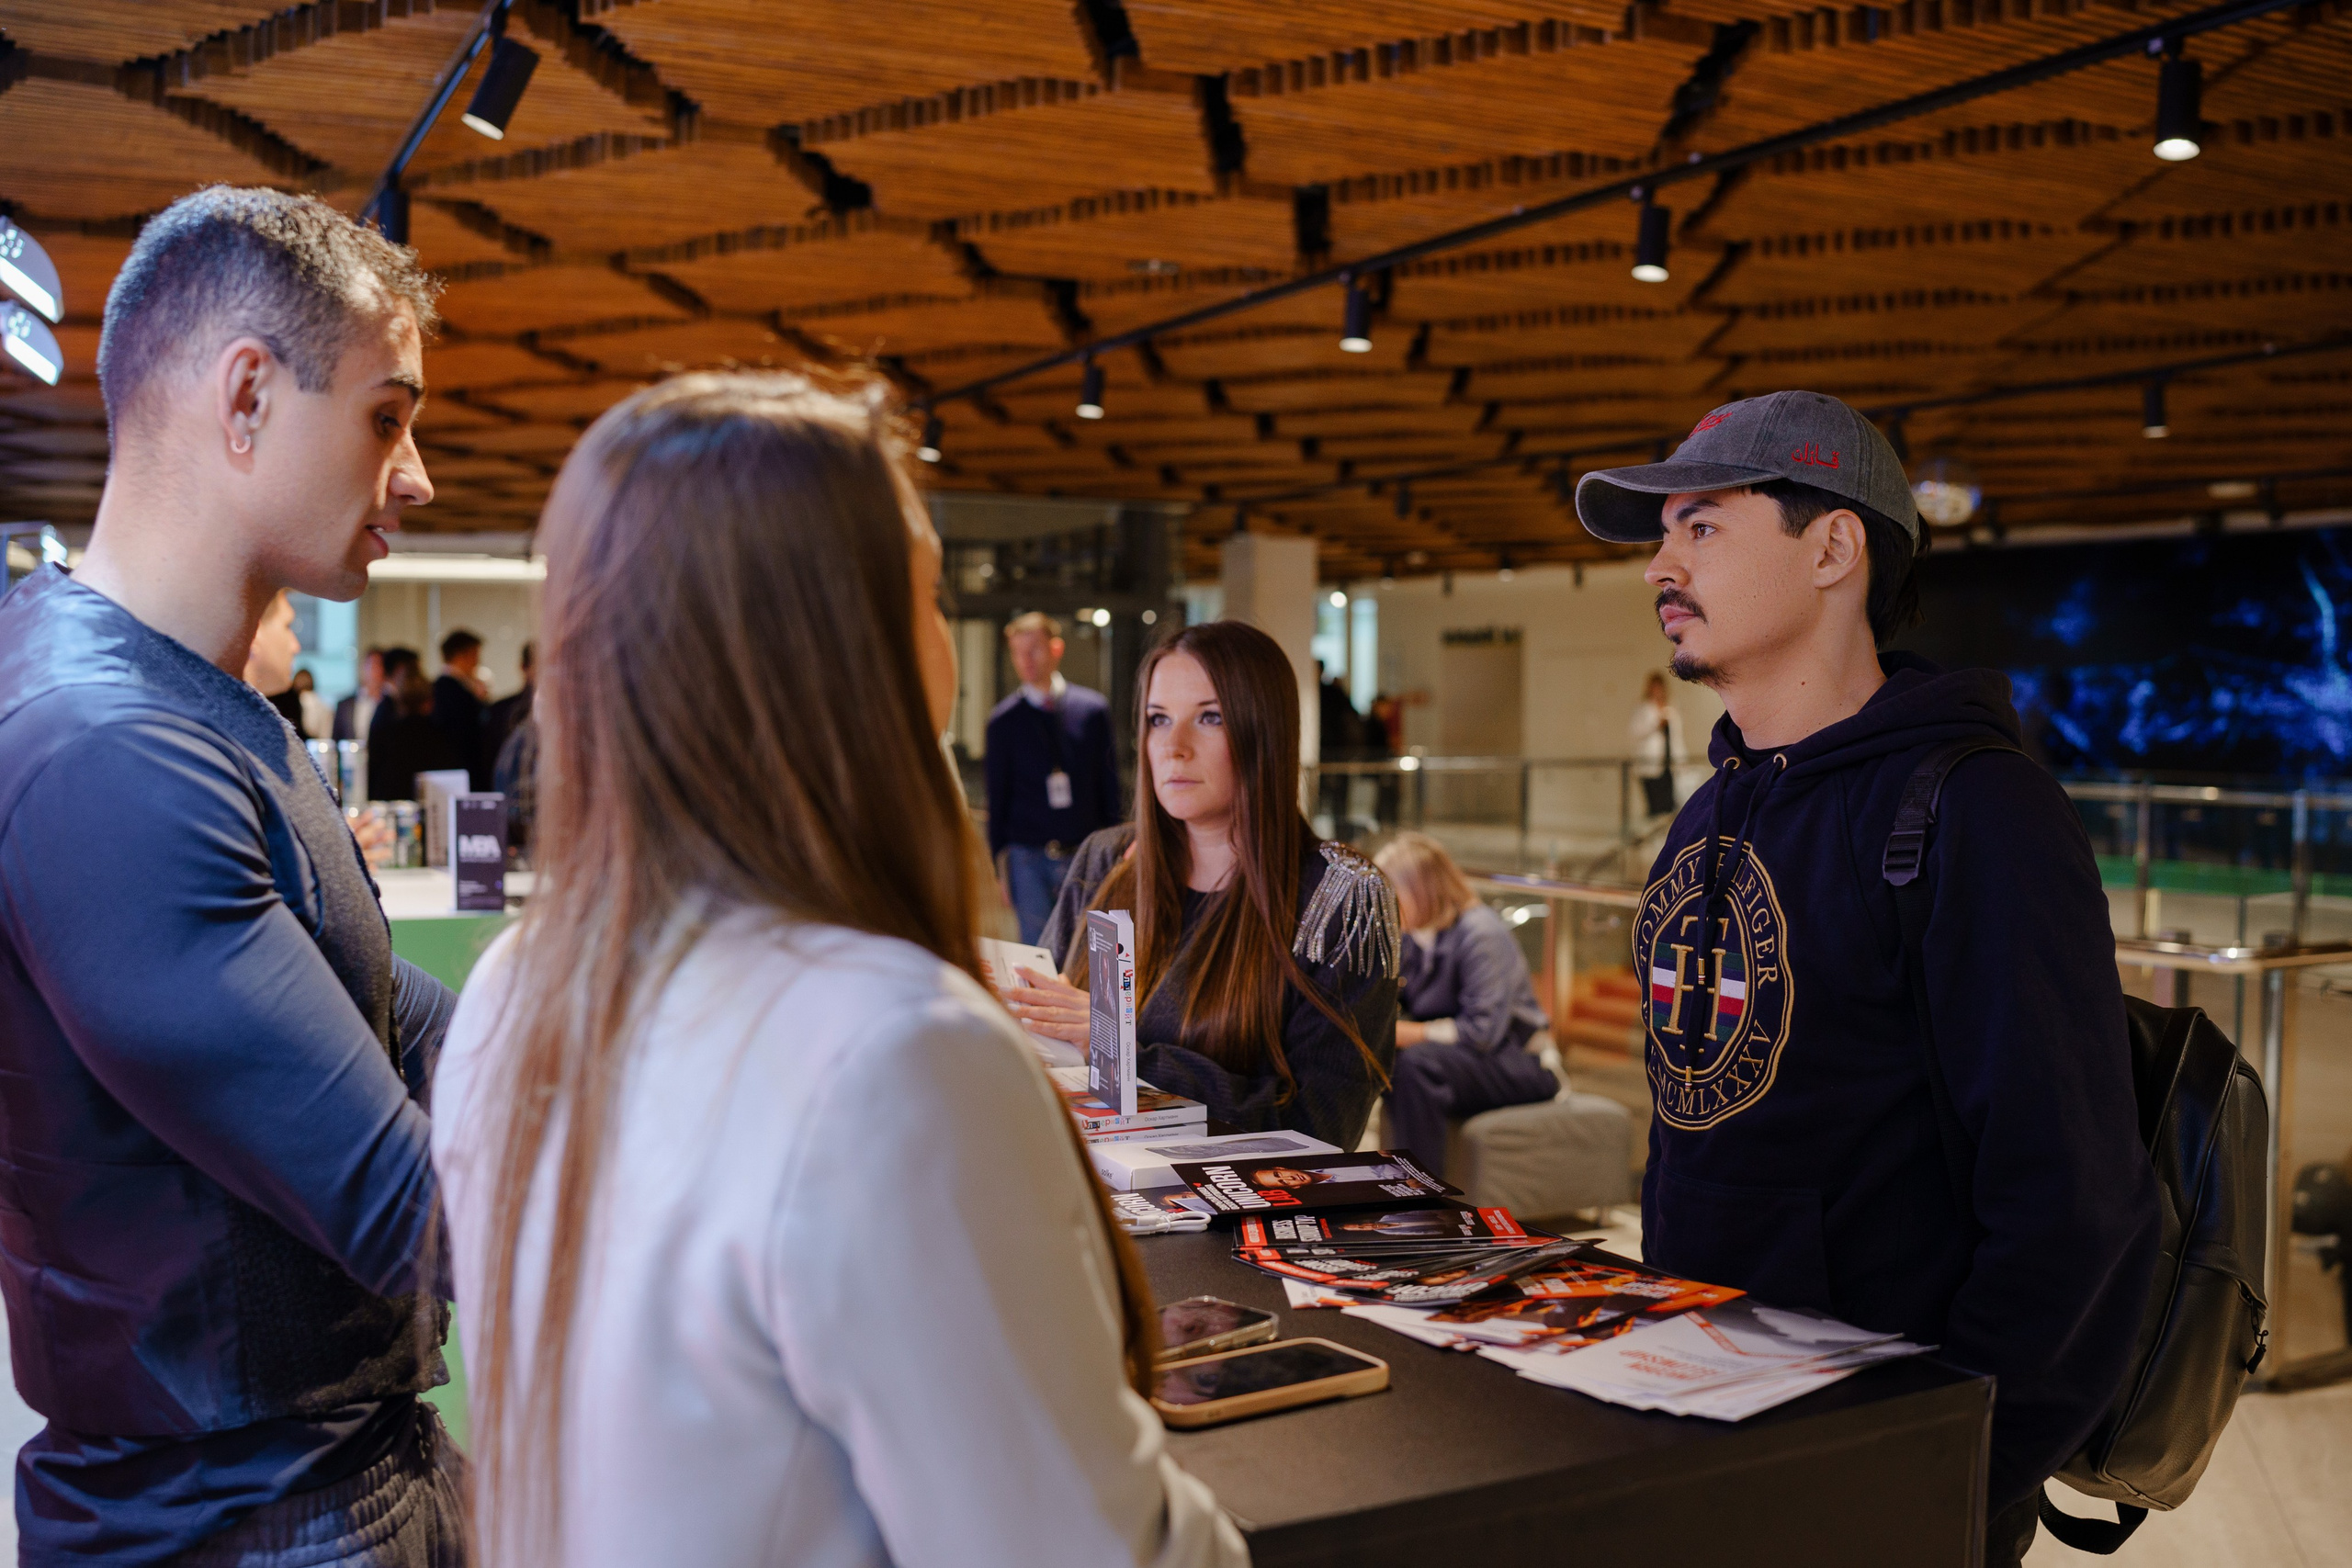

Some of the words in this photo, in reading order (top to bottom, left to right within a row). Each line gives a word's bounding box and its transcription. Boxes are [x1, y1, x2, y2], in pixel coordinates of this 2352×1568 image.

[1639, 855, 1701, 967] TOMMY
[1202, 1166, 1272, 1209] UNICORN
[1257, 1190, 1303, 1207] LAB
